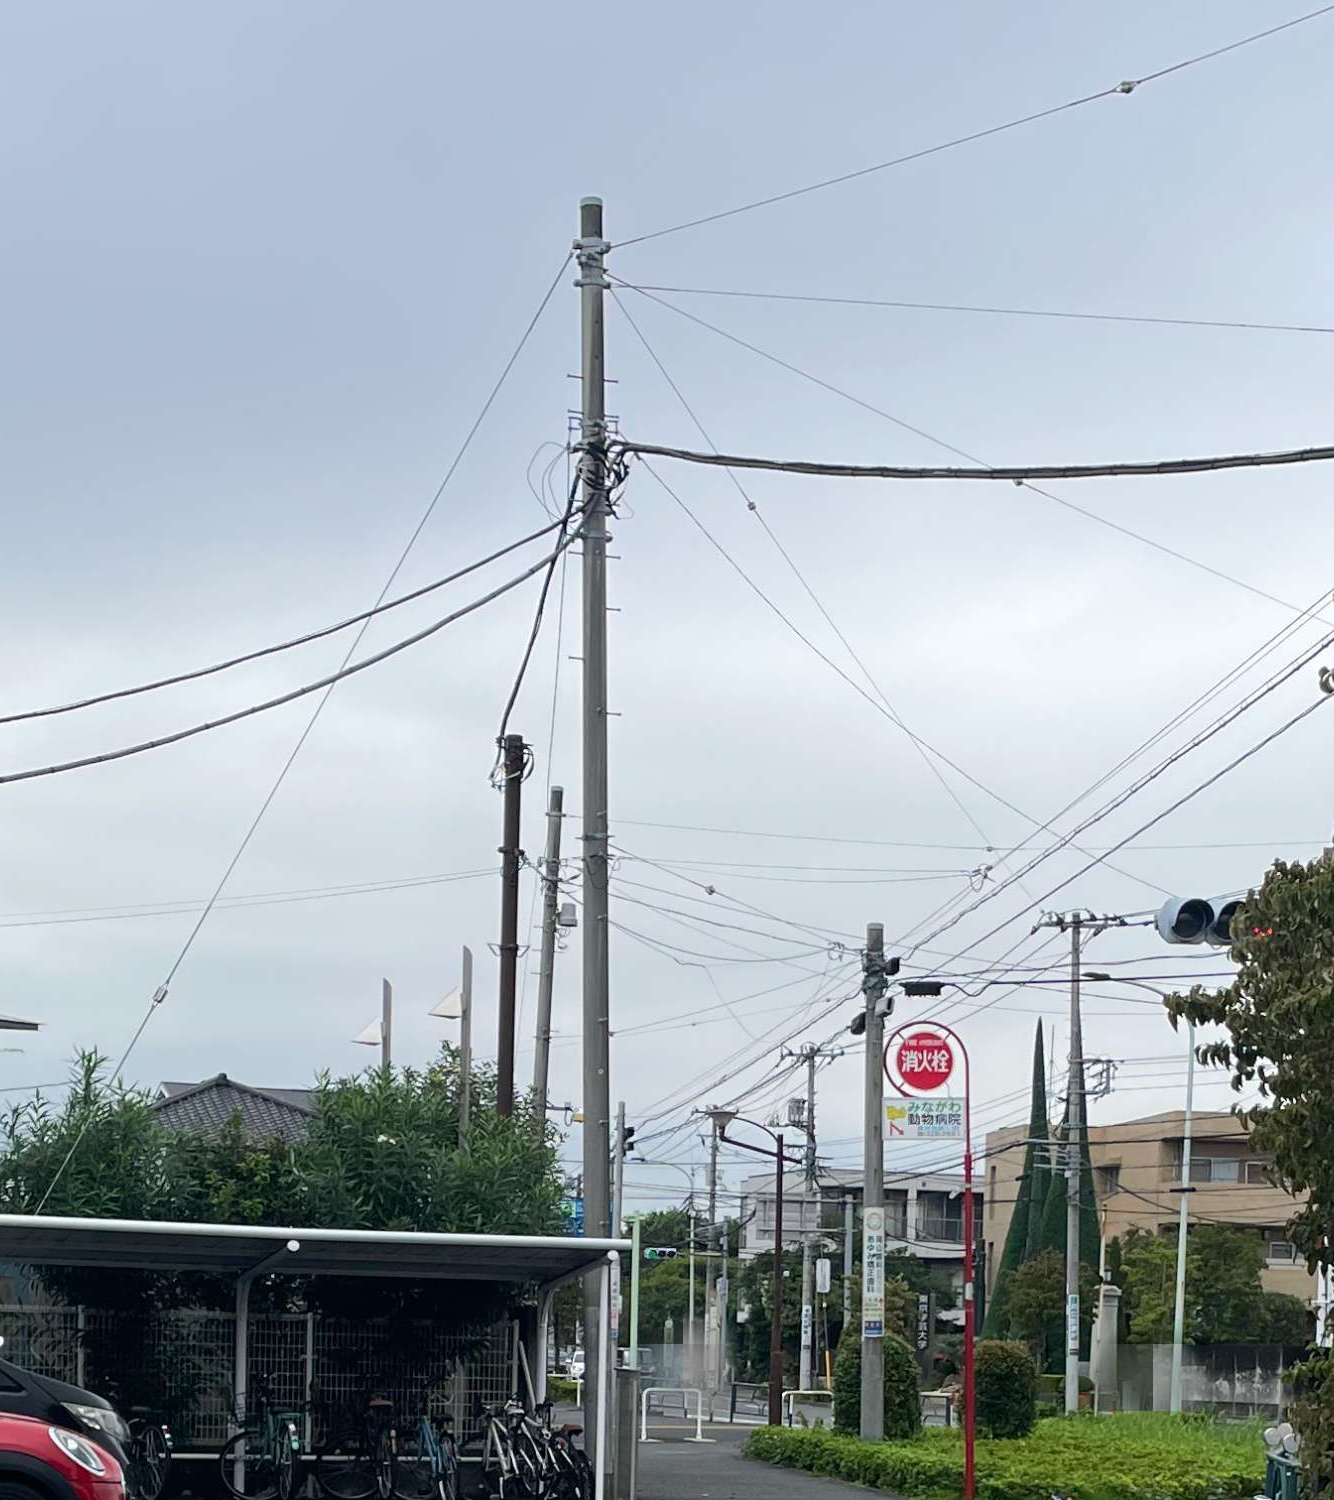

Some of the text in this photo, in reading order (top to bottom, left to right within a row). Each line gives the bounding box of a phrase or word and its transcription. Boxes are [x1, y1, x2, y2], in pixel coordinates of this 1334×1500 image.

[901, 1049, 950, 1073] 消火栓
[907, 1101, 962, 1113] みながわ
[907, 1113, 962, 1126] 動物病院
